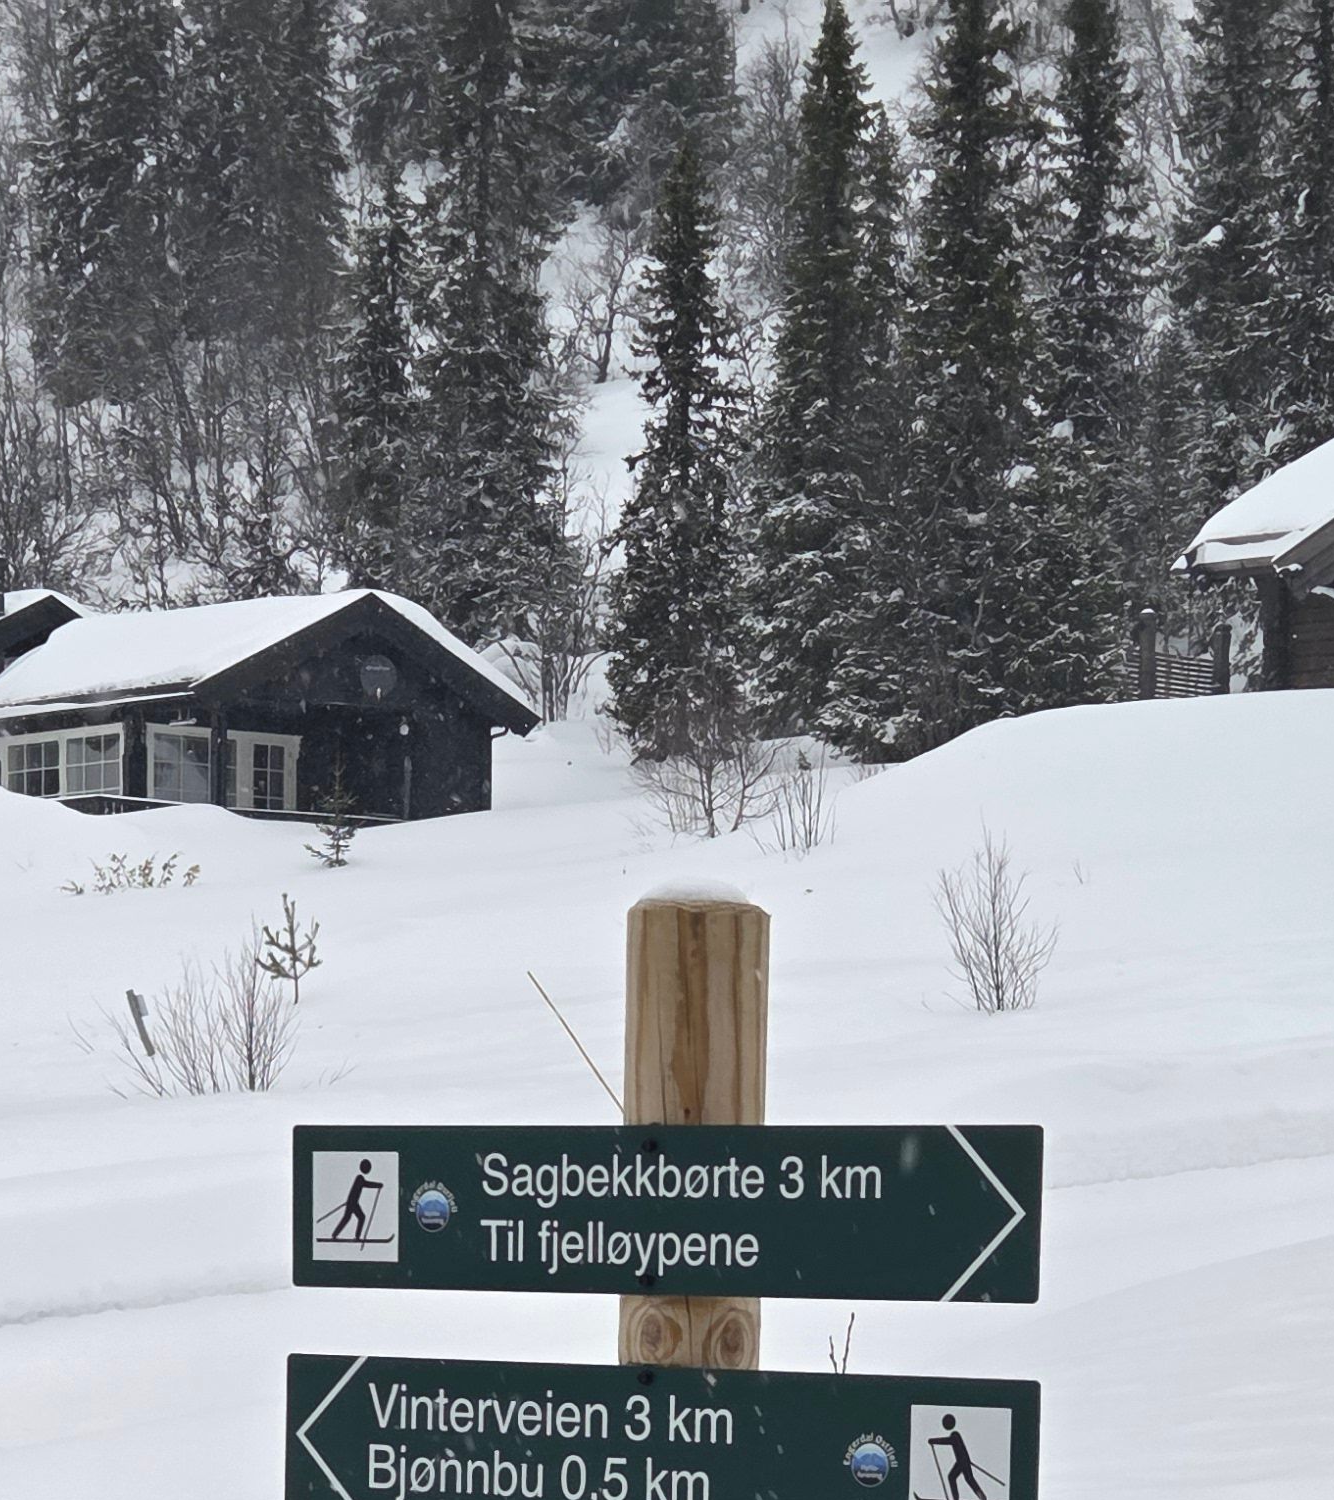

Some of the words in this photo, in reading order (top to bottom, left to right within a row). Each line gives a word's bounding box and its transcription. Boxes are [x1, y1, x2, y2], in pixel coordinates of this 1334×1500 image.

[482, 1153, 765, 1208] Sagbekkbørte
[779, 1156, 805, 1199] 3
[821, 1155, 882, 1199] km
[480, 1219, 524, 1262] Til
[538, 1220, 760, 1277] fjelløypene
[369, 1383, 608, 1438] Vinterveien
[624, 1395, 651, 1441] 3
[669, 1395, 733, 1444] km
